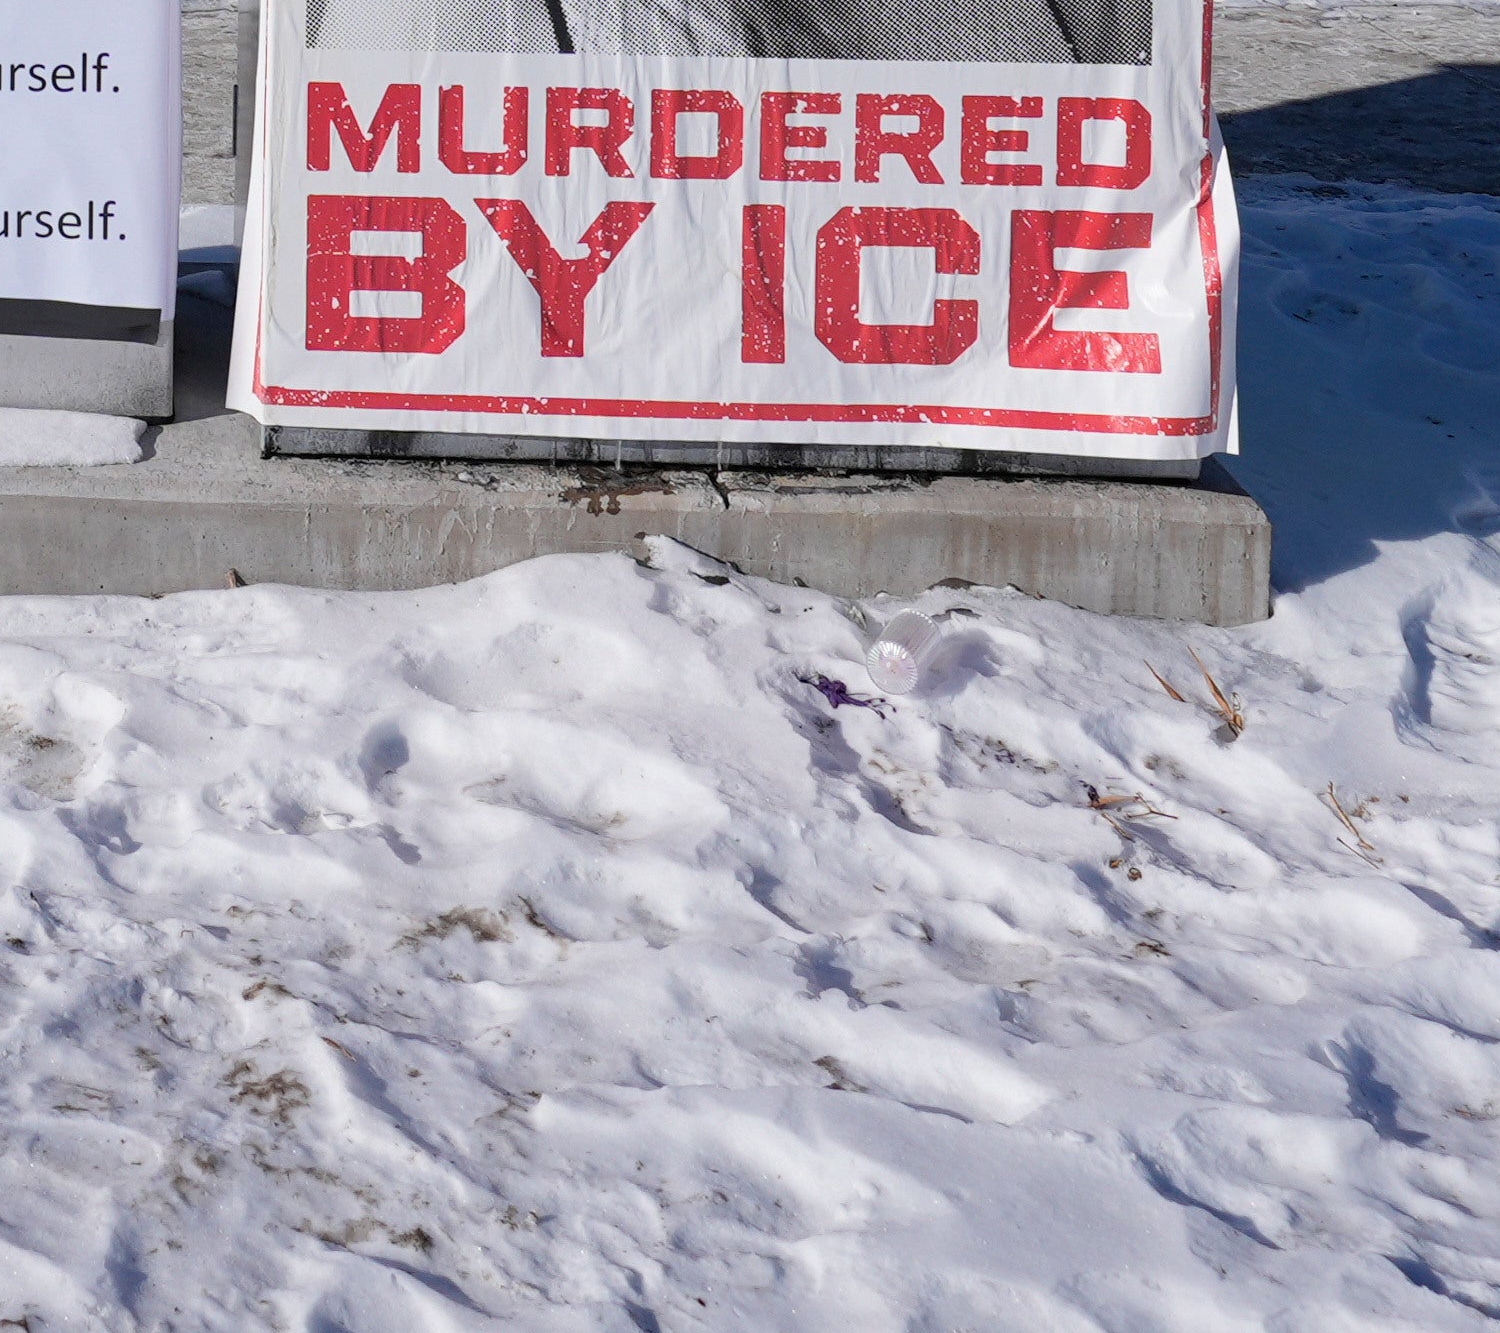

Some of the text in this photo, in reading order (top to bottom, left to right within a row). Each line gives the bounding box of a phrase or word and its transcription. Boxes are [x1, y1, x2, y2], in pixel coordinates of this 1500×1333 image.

[306, 81, 1153, 190] MURDERED
[305, 194, 1163, 374] BY ICE
